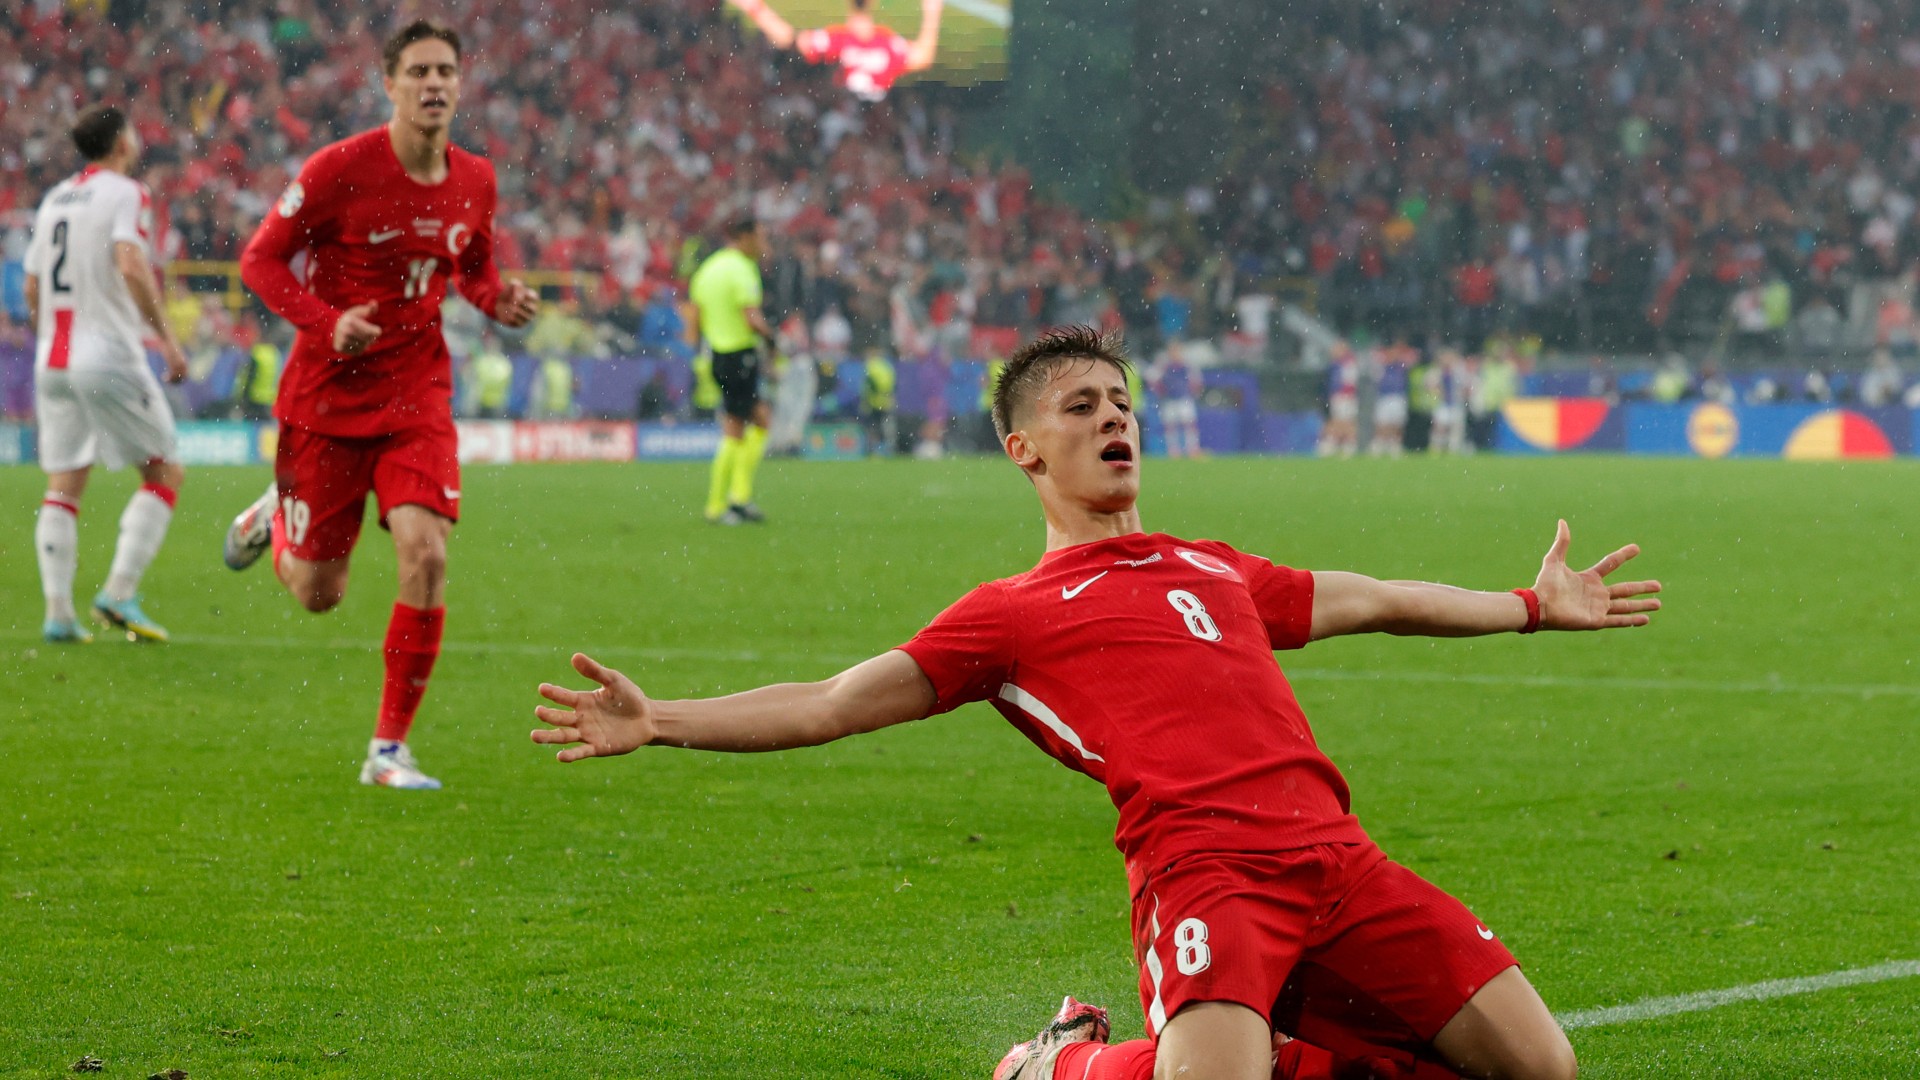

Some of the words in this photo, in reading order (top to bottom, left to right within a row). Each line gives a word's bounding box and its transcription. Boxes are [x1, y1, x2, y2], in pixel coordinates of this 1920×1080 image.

[53, 220, 71, 292] 2
[282, 496, 312, 546] 19
[1166, 589, 1223, 642] 8
[1174, 917, 1211, 976] 8
